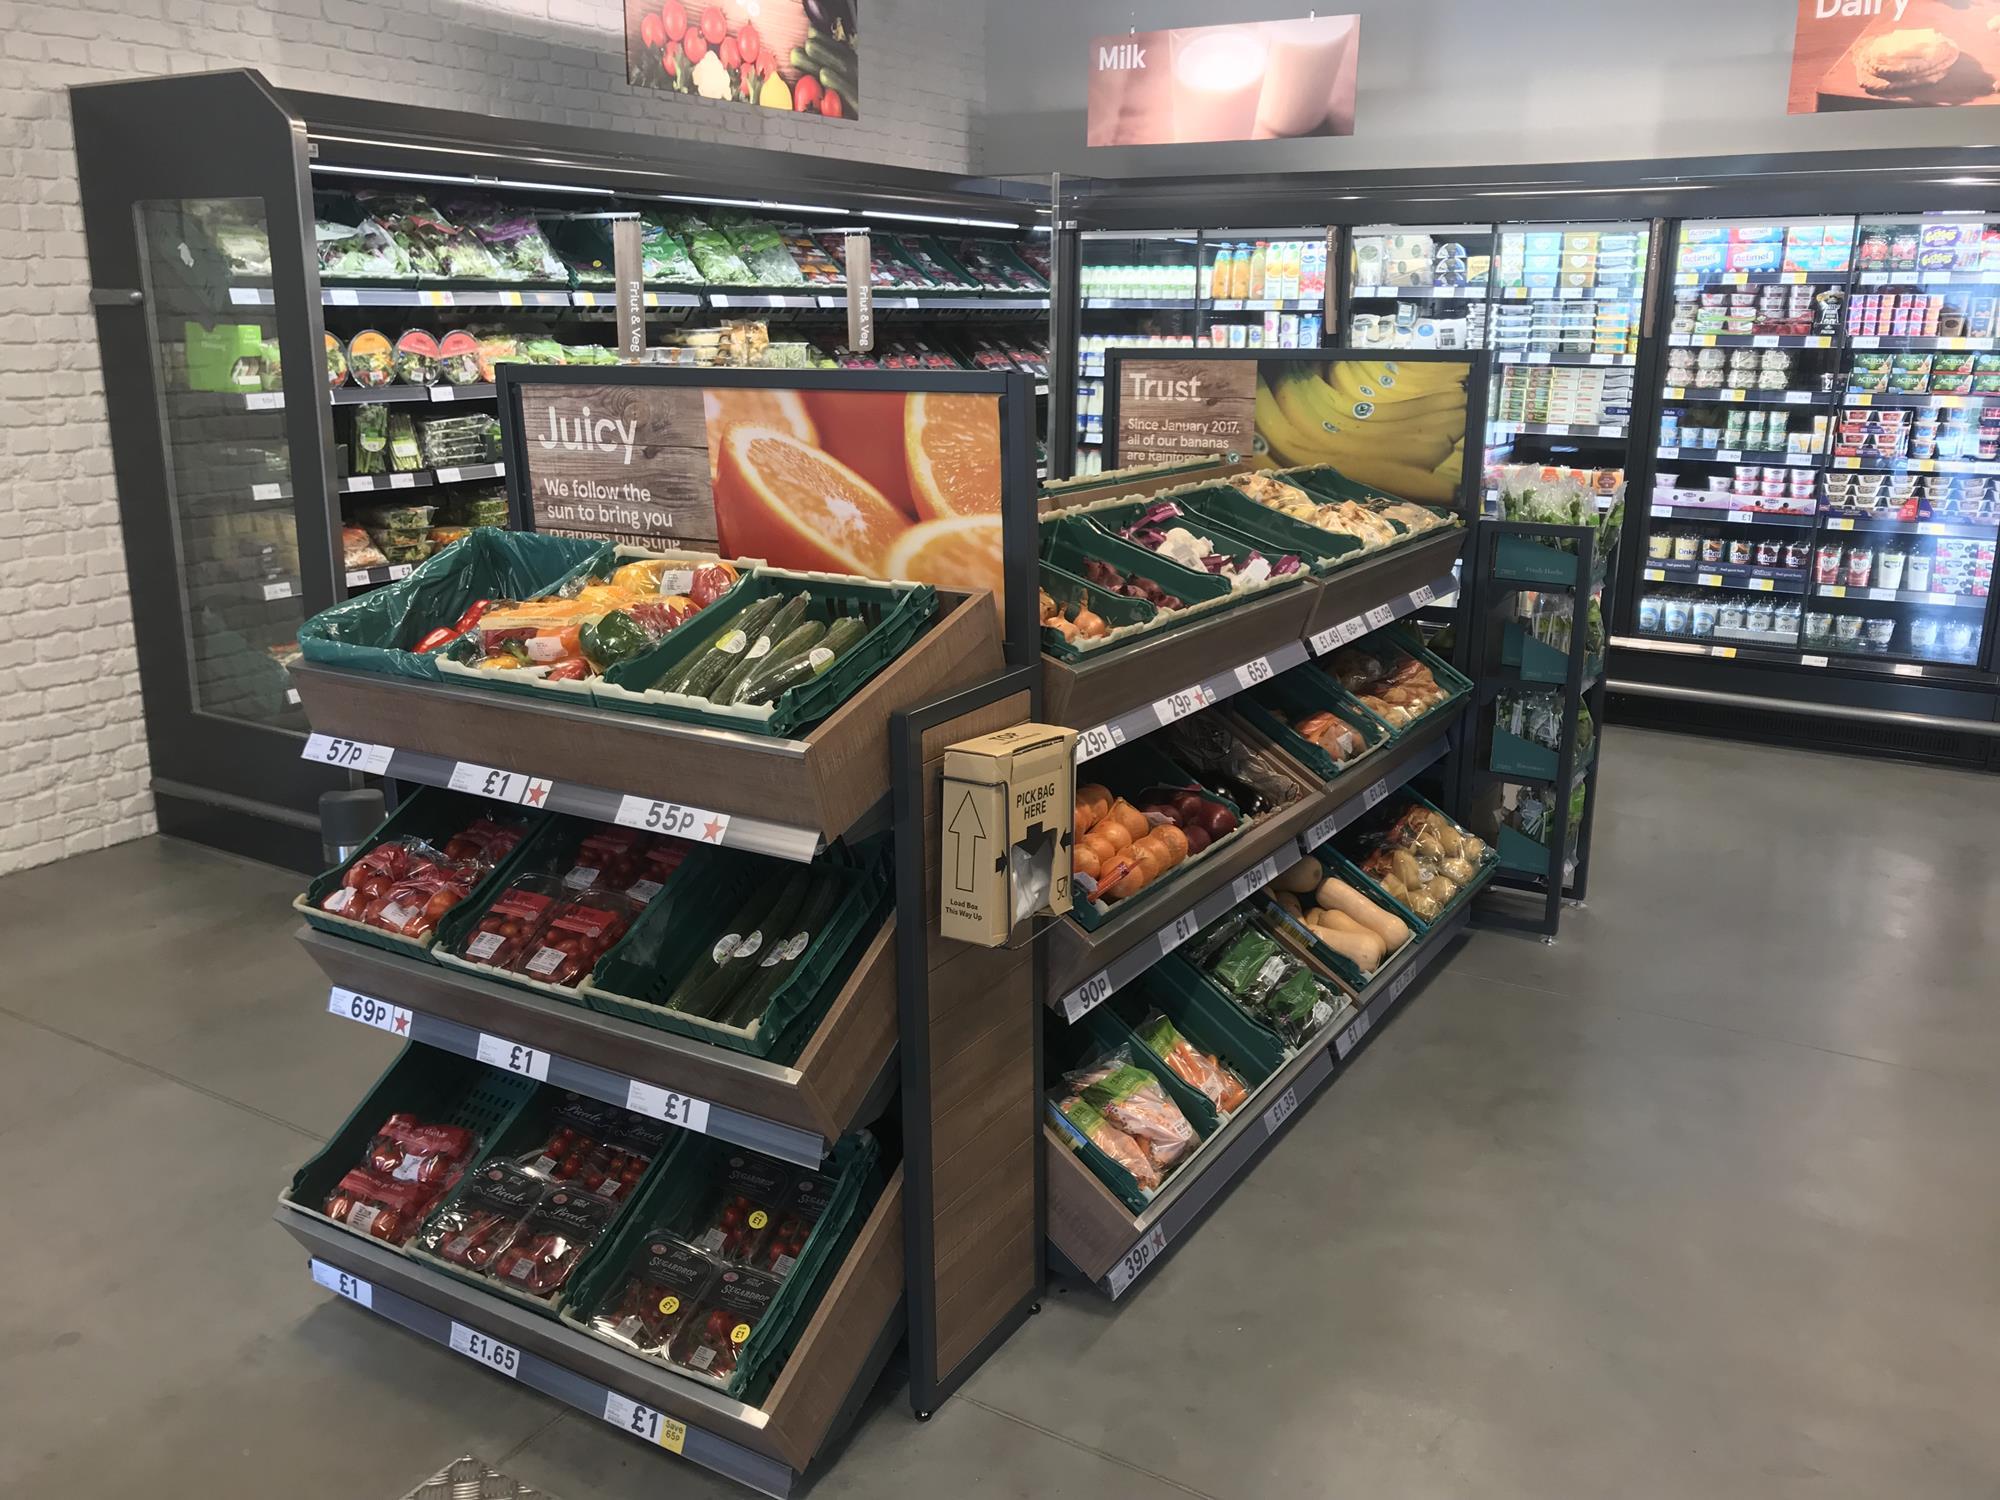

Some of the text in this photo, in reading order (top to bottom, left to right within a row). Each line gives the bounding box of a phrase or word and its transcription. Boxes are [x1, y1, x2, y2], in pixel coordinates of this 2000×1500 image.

[1816, 0, 1908, 22] Dairy
[1099, 43, 1147, 71] Milk
[1683, 253, 1716, 264] Actimel
[1734, 252, 1770, 264] Actimel
[631, 315, 641, 325] &
[860, 314, 870, 323] &
[630, 327, 642, 352] Veg
[859, 324, 870, 347] Veg
[1129, 372, 1202, 402] Trust
[538, 406, 637, 465] Juicy
[1128, 418, 1159, 431] Since
[1161, 419, 1208, 435] January
[1127, 433, 1230, 449] all of our bananas
[1127, 450, 1145, 461] are
[544, 477, 651, 502] We follow the
[547, 503, 673, 530] sun to bring you
[1741, 513, 1752, 522] £1
[401, 567, 411, 577] £2
[1319, 628, 1341, 650] £1.49
[1247, 658, 1268, 683] 65p
[1167, 693, 1192, 718] 29p
[326, 738, 362, 765] 57p
[1078, 730, 1107, 757] 29p
[482, 770, 512, 797] £1
[1016, 782, 1055, 808] PICK BAG
[645, 801, 695, 833] 55p
[1023, 800, 1047, 820] HERE
[1244, 866, 1263, 893] 79p
[945, 905, 983, 921] This Way Up
[950, 898, 979, 911] Load Box
[1176, 917, 1191, 941] £1
[1079, 977, 1107, 1010] 90p
[351, 995, 386, 1026] 69p
[1347, 1024, 1361, 1046] £1
[509, 1045, 534, 1073] £1
[663, 1093, 692, 1124] £1
[1273, 1089, 1296, 1123] £1.35
[649, 1256, 698, 1280] SUGARDROP
[1125, 1244, 1149, 1280] 39p
[339, 1273, 358, 1299] £1
[720, 1284, 771, 1305] SUGARDROP
[734, 1328, 746, 1339] £1
[469, 1334, 515, 1371] £1.65
[631, 1405, 660, 1439] £1
[665, 1419, 684, 1434] Save
[665, 1429, 682, 1442] 65p
